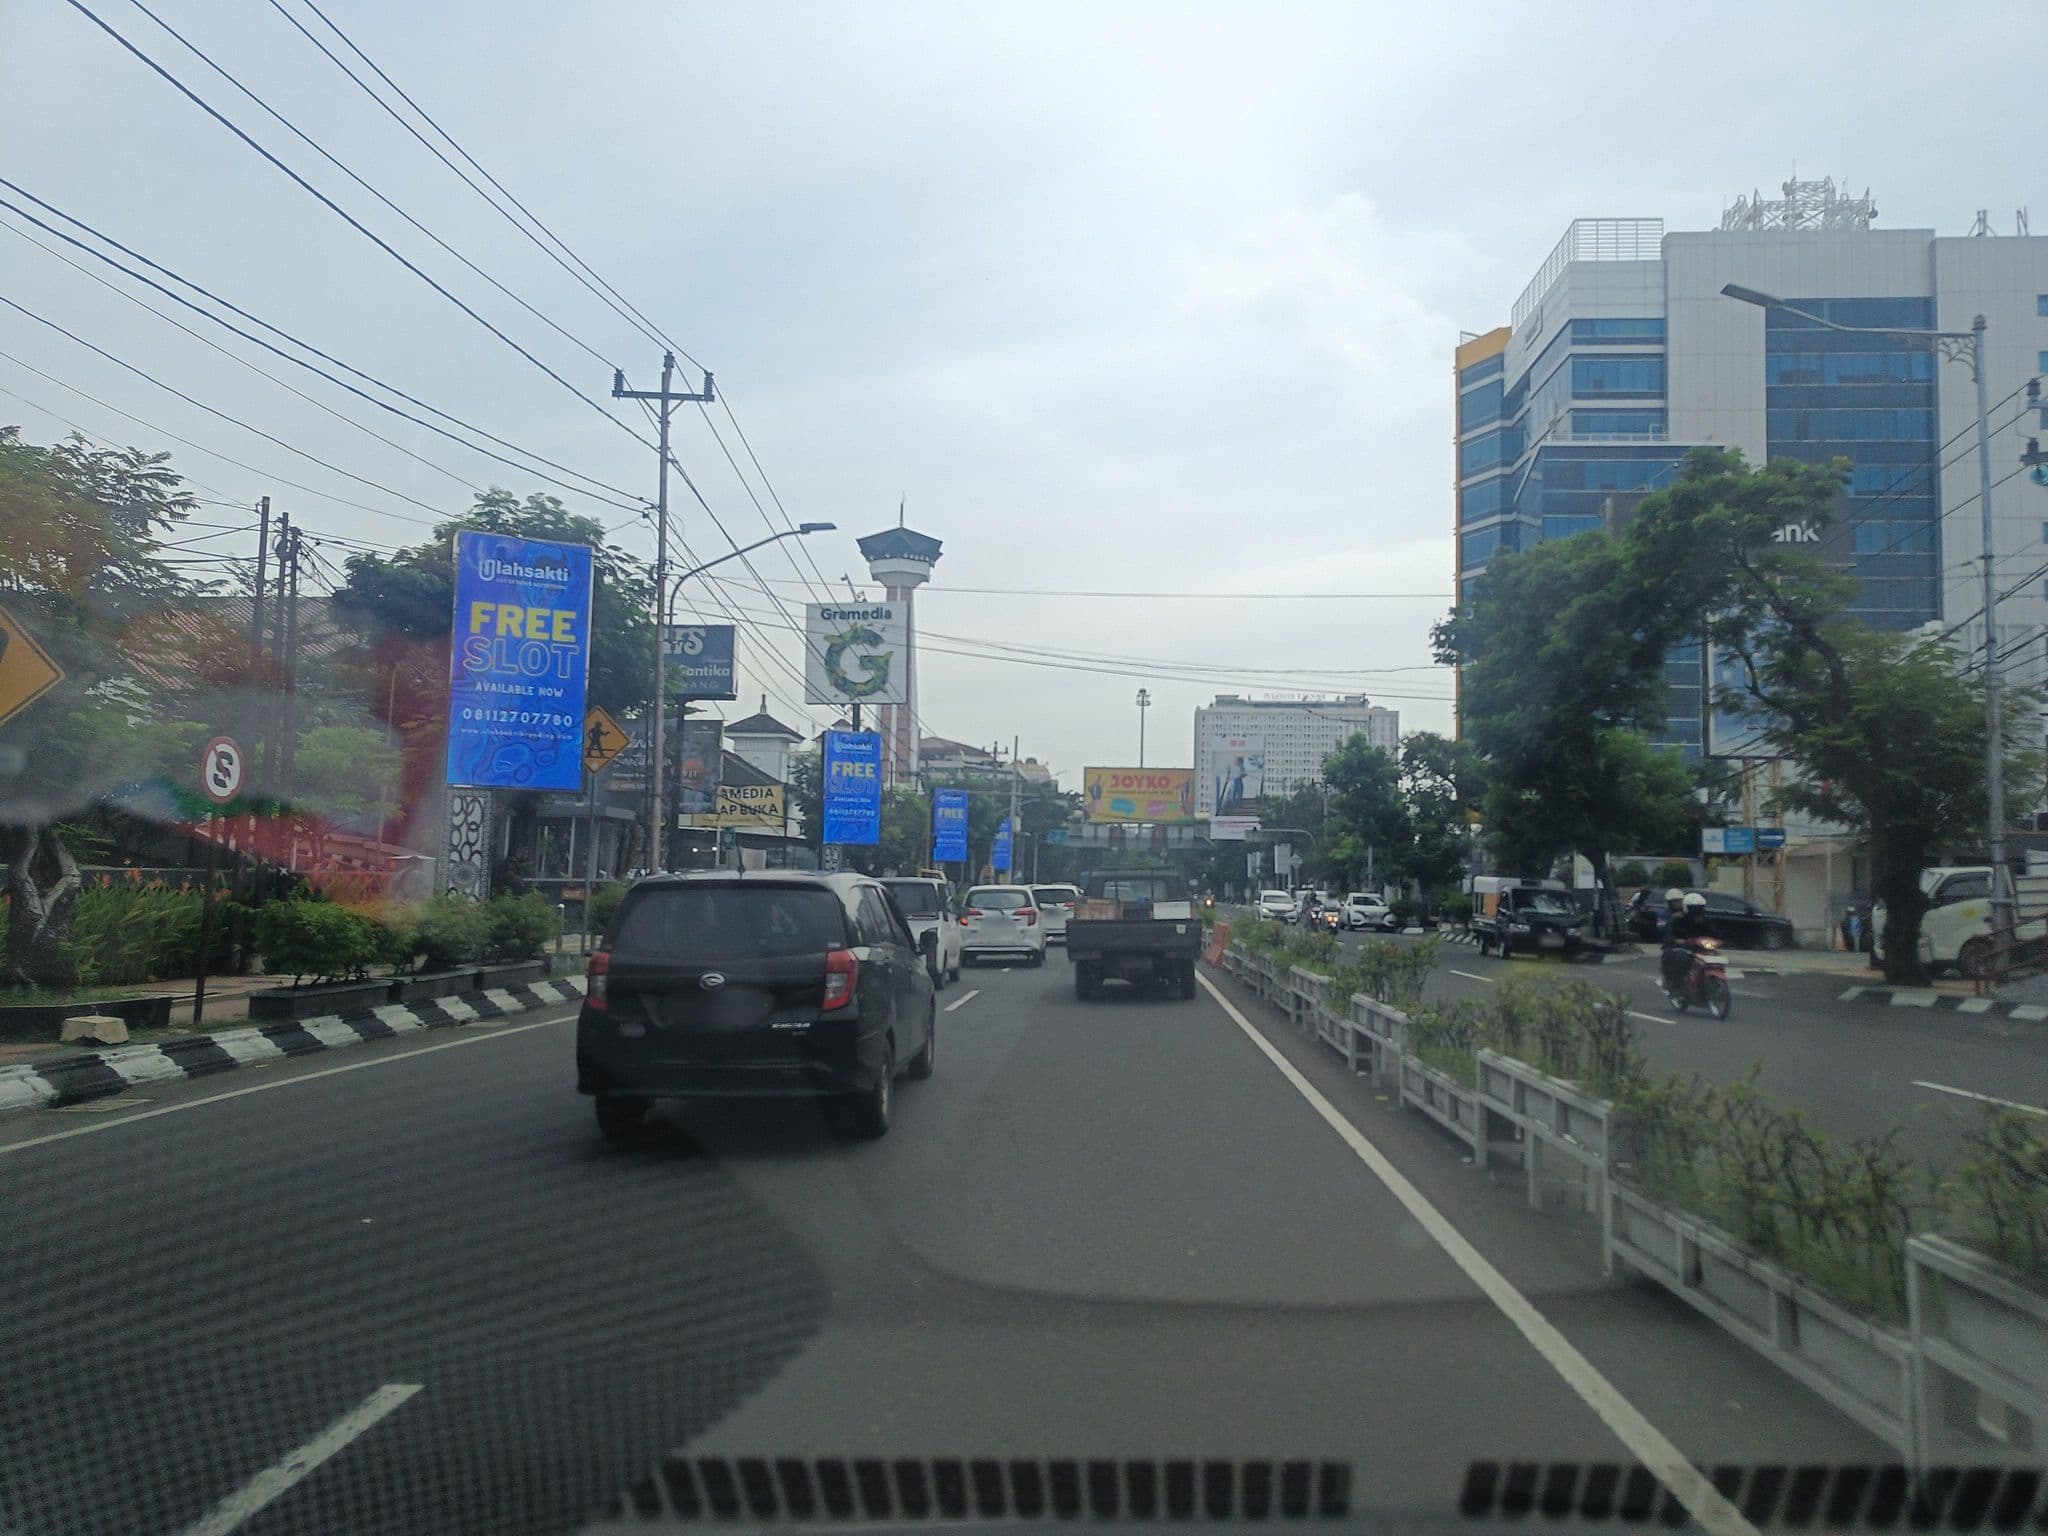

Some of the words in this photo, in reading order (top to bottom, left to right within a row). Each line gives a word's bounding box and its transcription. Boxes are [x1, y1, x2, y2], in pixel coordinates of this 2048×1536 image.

[1769, 520, 1820, 542] ank
[470, 601, 576, 643] FREE
[821, 607, 892, 620] Gramedia
[462, 636, 580, 679] SLOT
[475, 681, 534, 696] AVAILABLE
[538, 688, 564, 698] NOW
[462, 708, 573, 728] 08112707780
[831, 761, 876, 778] FREE
[1109, 774, 1171, 789] JOYKO
[720, 787, 774, 799] AMEDIA
